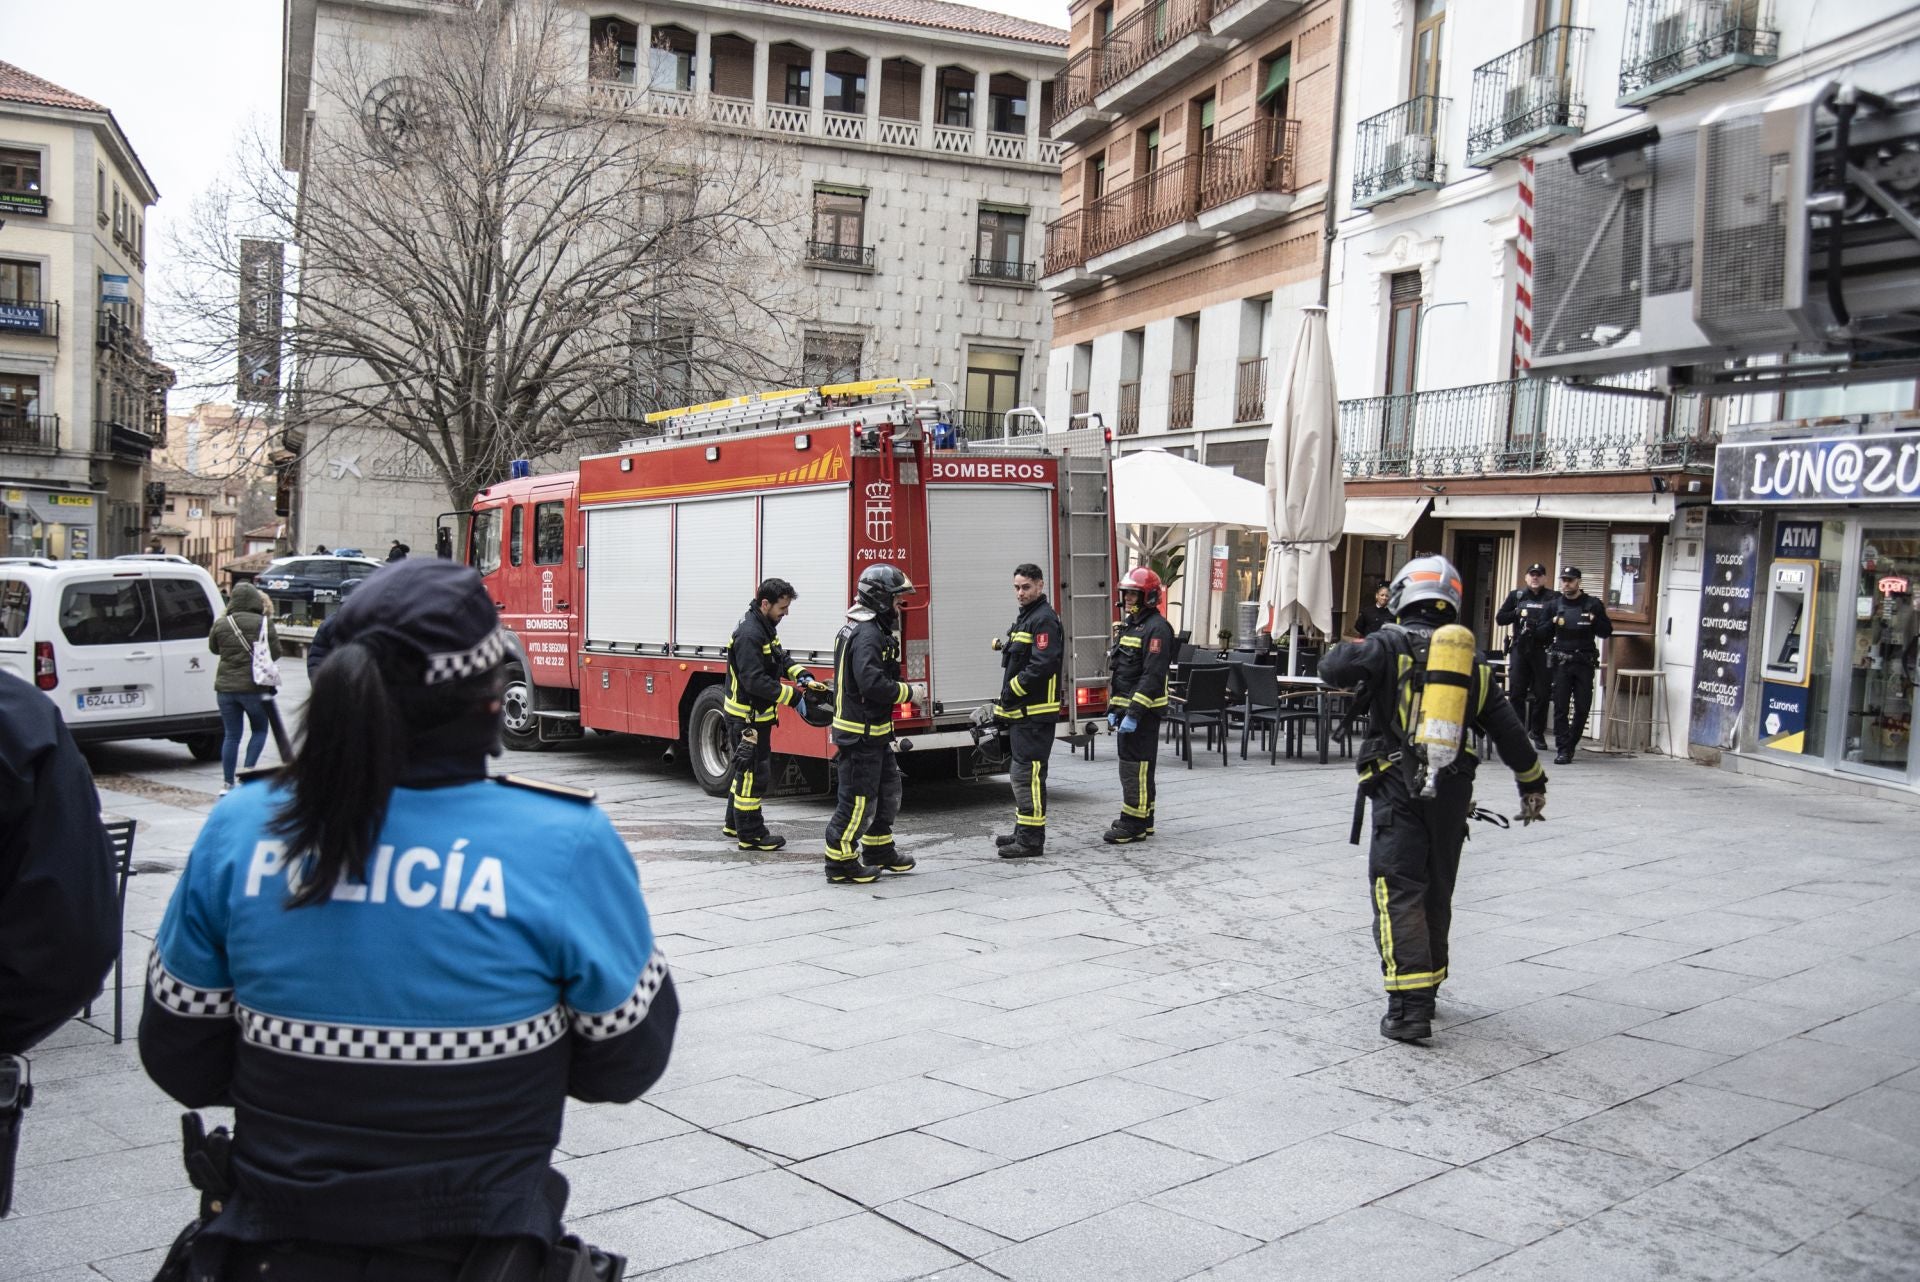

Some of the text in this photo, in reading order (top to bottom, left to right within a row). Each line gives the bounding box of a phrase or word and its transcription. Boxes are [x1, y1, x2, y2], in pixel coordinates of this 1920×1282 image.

[932, 463, 1044, 478] BOMBEROS
[61, 496, 89, 505] ONCE
[1780, 527, 1817, 548] ATM
[864, 548, 877, 560] 921
[878, 548, 887, 560] 42
[897, 548, 906, 560] 22
[1715, 553, 1744, 566] BOLSOS
[1704, 585, 1750, 599] MONEDEROS
[1879, 582, 1907, 598] open
[526, 619, 568, 630] BOMBEROS
[1701, 617, 1748, 632] CINTURONES
[542, 643, 548, 652] DE
[548, 643, 568, 653] SEGOVIA
[1702, 649, 1741, 664] PAÑUELOS
[1697, 681, 1738, 697] ARTÍCULOS
[86, 692, 139, 706] 6244 LDP
[1716, 694, 1735, 706] PELO
[1769, 698, 1799, 713] Euronet
